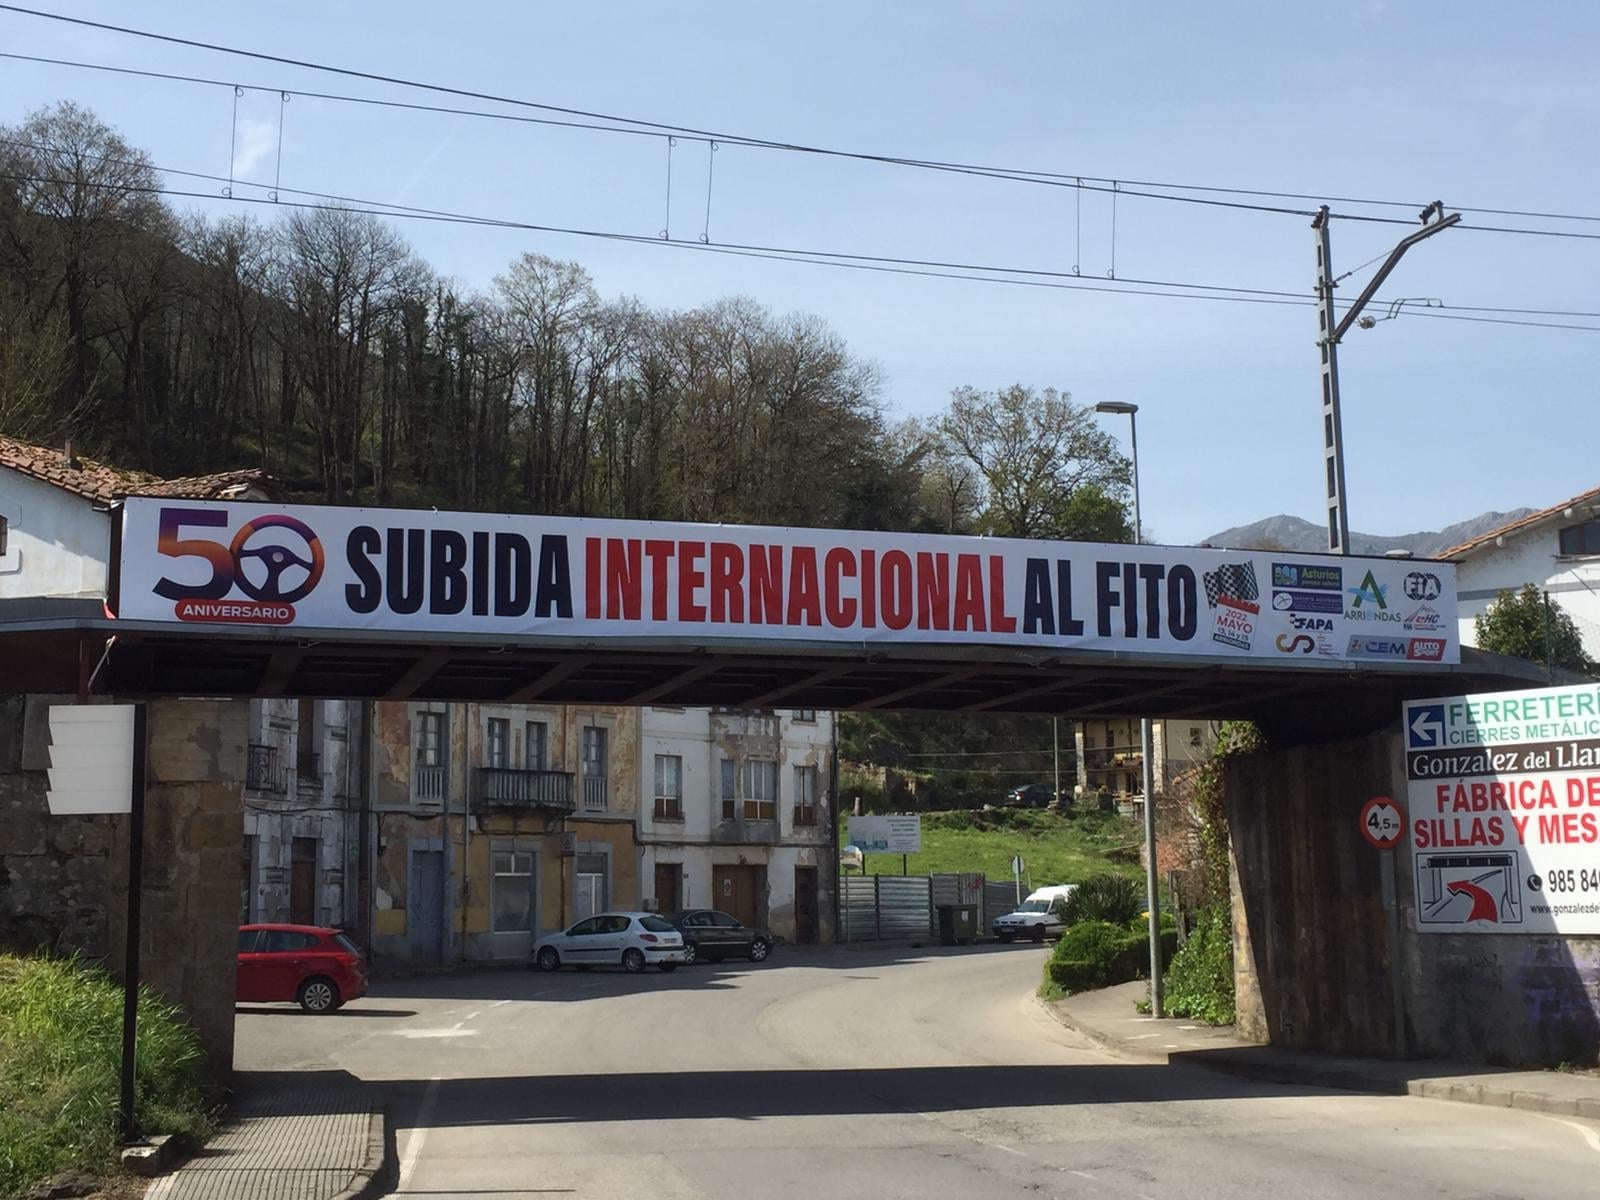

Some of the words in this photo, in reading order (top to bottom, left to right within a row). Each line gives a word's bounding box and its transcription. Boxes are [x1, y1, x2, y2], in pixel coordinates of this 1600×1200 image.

[1302, 567, 1340, 580] Asturias
[345, 525, 574, 619] SUBIDA
[585, 537, 1017, 633] INTERNACIONAL
[1023, 557, 1085, 636] AL
[1096, 561, 1198, 641] FITO
[183, 604, 289, 619] ANIVERSARIO
[1225, 609, 1248, 622] 2022
[1216, 615, 1253, 634] MAYO
[1299, 617, 1334, 631] FAPA
[1413, 648, 1440, 657] SPORT
[1414, 641, 1440, 650] AUTO
[1450, 727, 1521, 745] CIERRES
[1526, 719, 1600, 738] METÁLIC
[1413, 748, 1518, 776] Gonzalez
[1523, 751, 1551, 769] del
[1436, 779, 1557, 813] FÁBRICA
[1567, 777, 1600, 808] DE
[1414, 816, 1505, 848] SILLAS
[1512, 816, 1530, 845] Y
[1539, 813, 1600, 844] MES
[1548, 869, 1576, 893] 985
[1580, 869, 1600, 893] 84
[1530, 902, 1600, 917] www.gonzalezde
